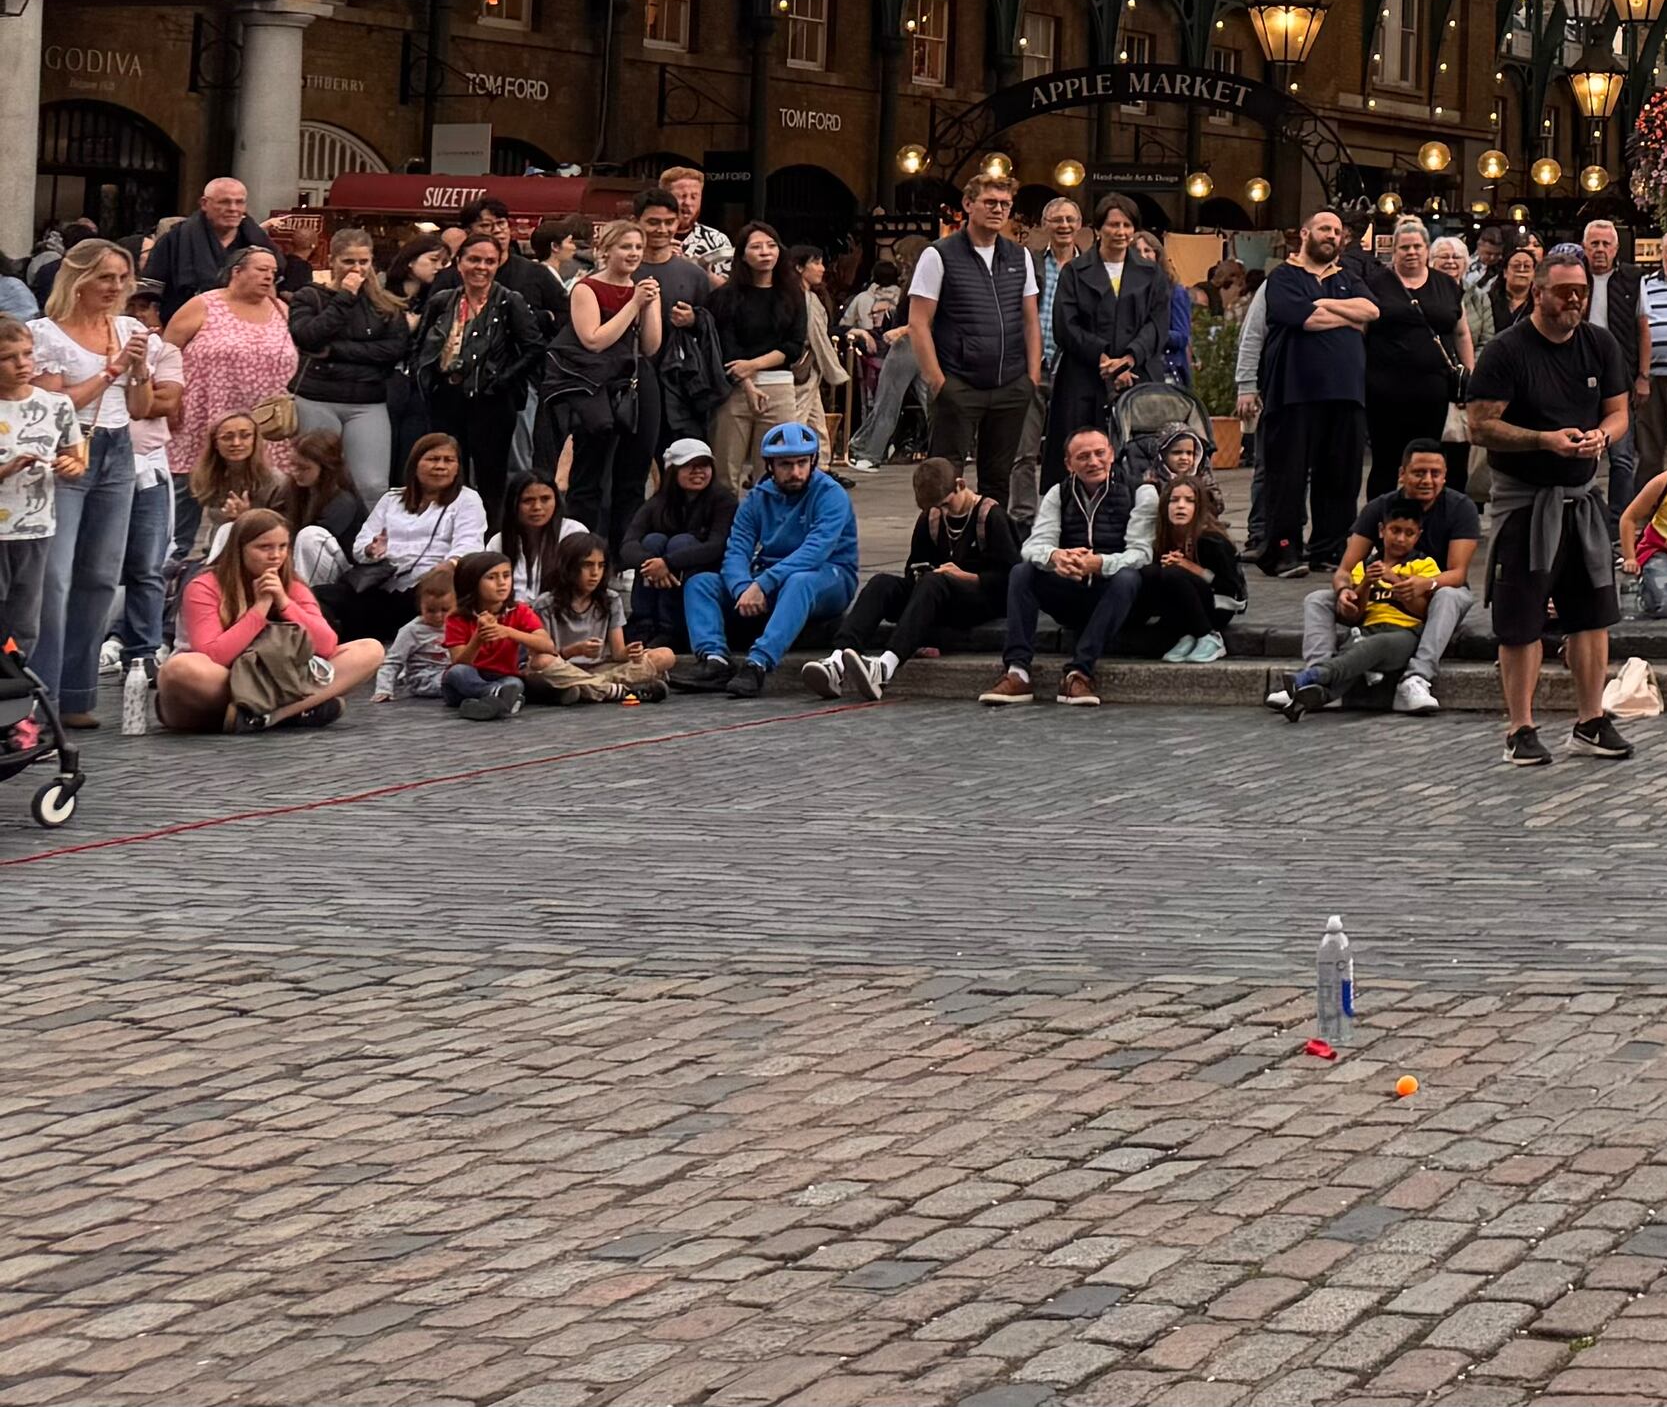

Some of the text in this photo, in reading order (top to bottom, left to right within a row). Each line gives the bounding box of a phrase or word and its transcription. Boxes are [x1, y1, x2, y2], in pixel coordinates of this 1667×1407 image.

[44, 45, 143, 77] GODIVA
[465, 73, 549, 101] TOM FORD
[1031, 72, 1253, 109] APPLE MARKET
[779, 108, 841, 131] TOM FORD
[706, 172, 751, 181] TOM FORD
